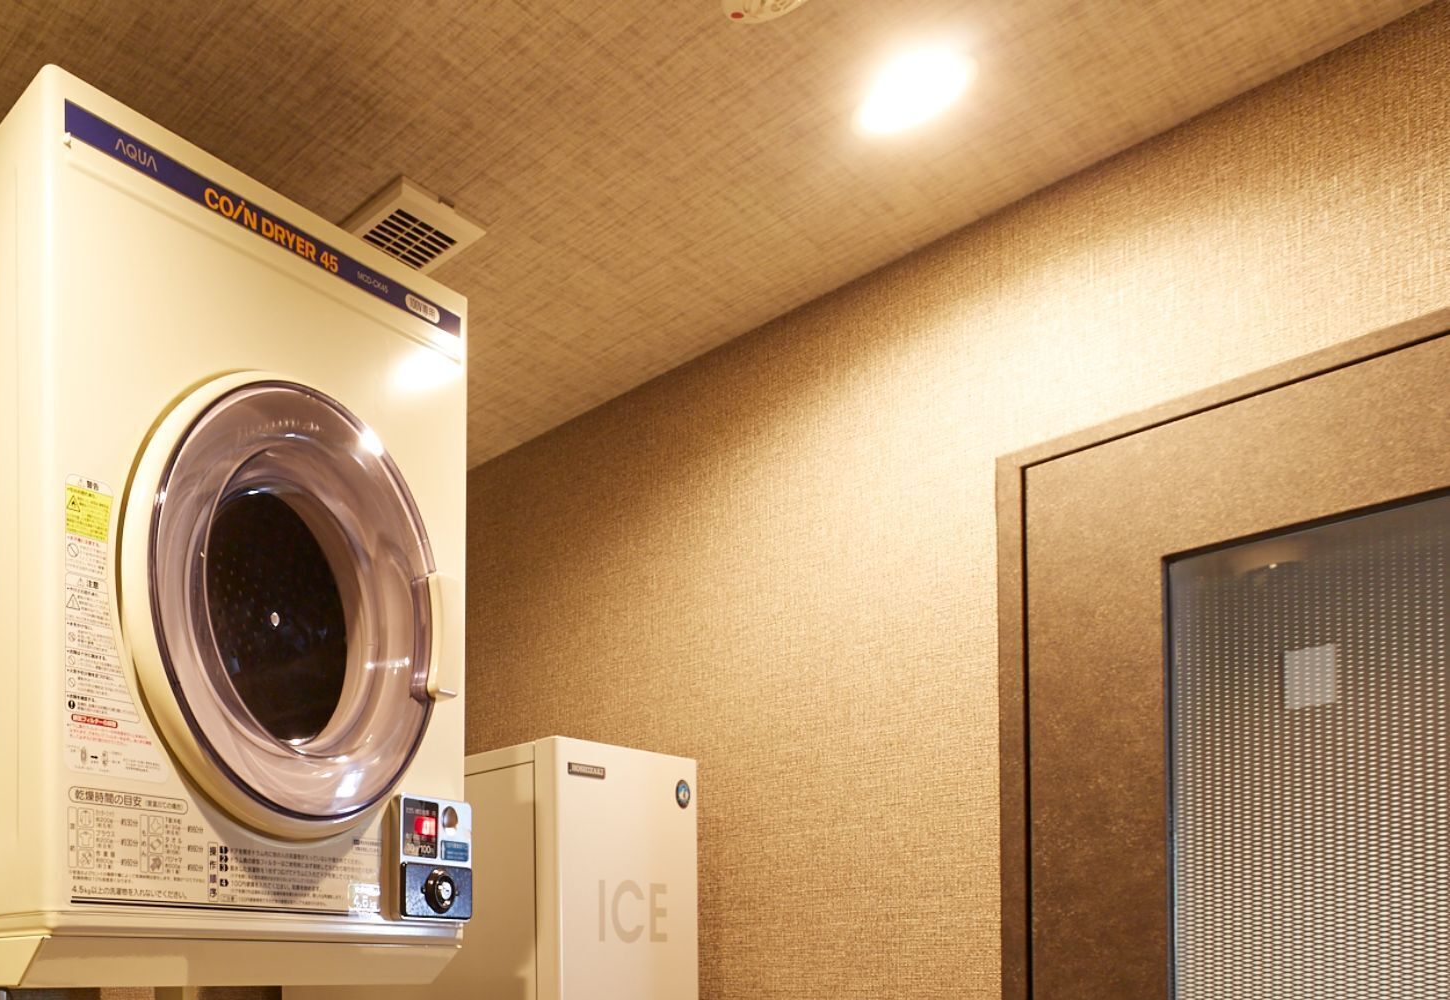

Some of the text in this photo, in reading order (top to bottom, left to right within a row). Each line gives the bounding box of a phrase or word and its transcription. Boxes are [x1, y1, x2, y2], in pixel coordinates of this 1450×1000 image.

[114, 137, 158, 173] AQUA
[261, 212, 317, 262] DRYER
[319, 249, 339, 274] 45
[75, 789, 143, 808] 乾燥時間の目安
[598, 879, 668, 945] ICE
